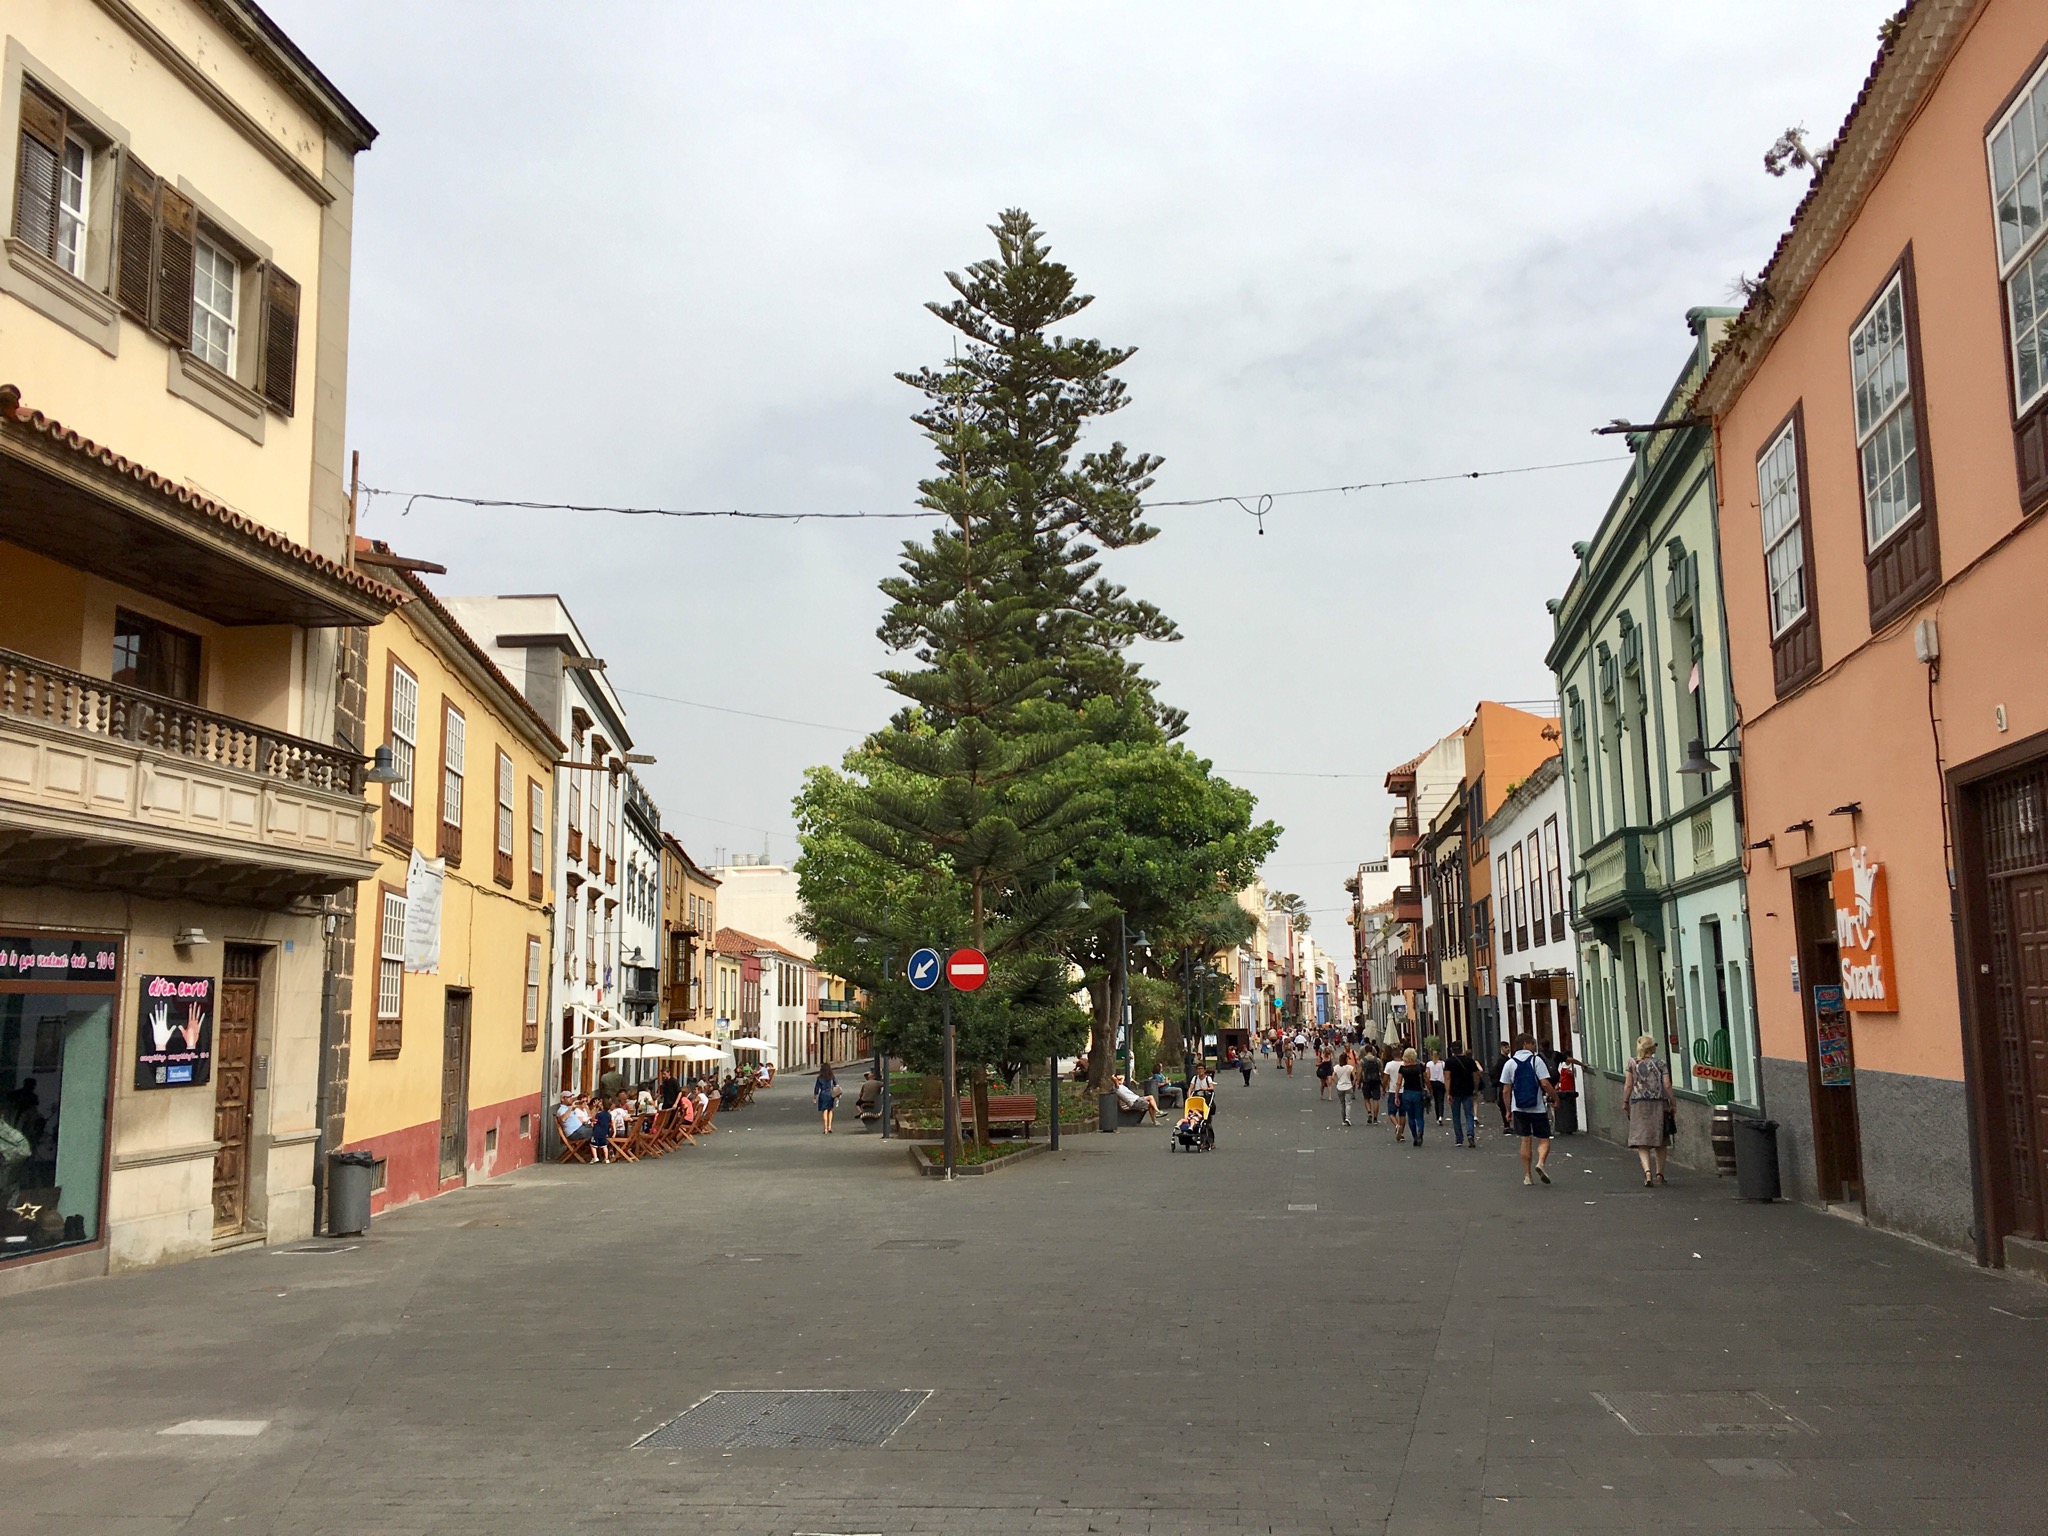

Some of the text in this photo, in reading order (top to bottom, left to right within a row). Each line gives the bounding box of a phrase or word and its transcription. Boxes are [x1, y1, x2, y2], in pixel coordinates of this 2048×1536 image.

[1996, 707, 2003, 728] 9
[9, 949, 18, 967] lo
[19, 954, 36, 973] que
[148, 976, 209, 998] diez euros
[1841, 954, 1885, 999] Snack
